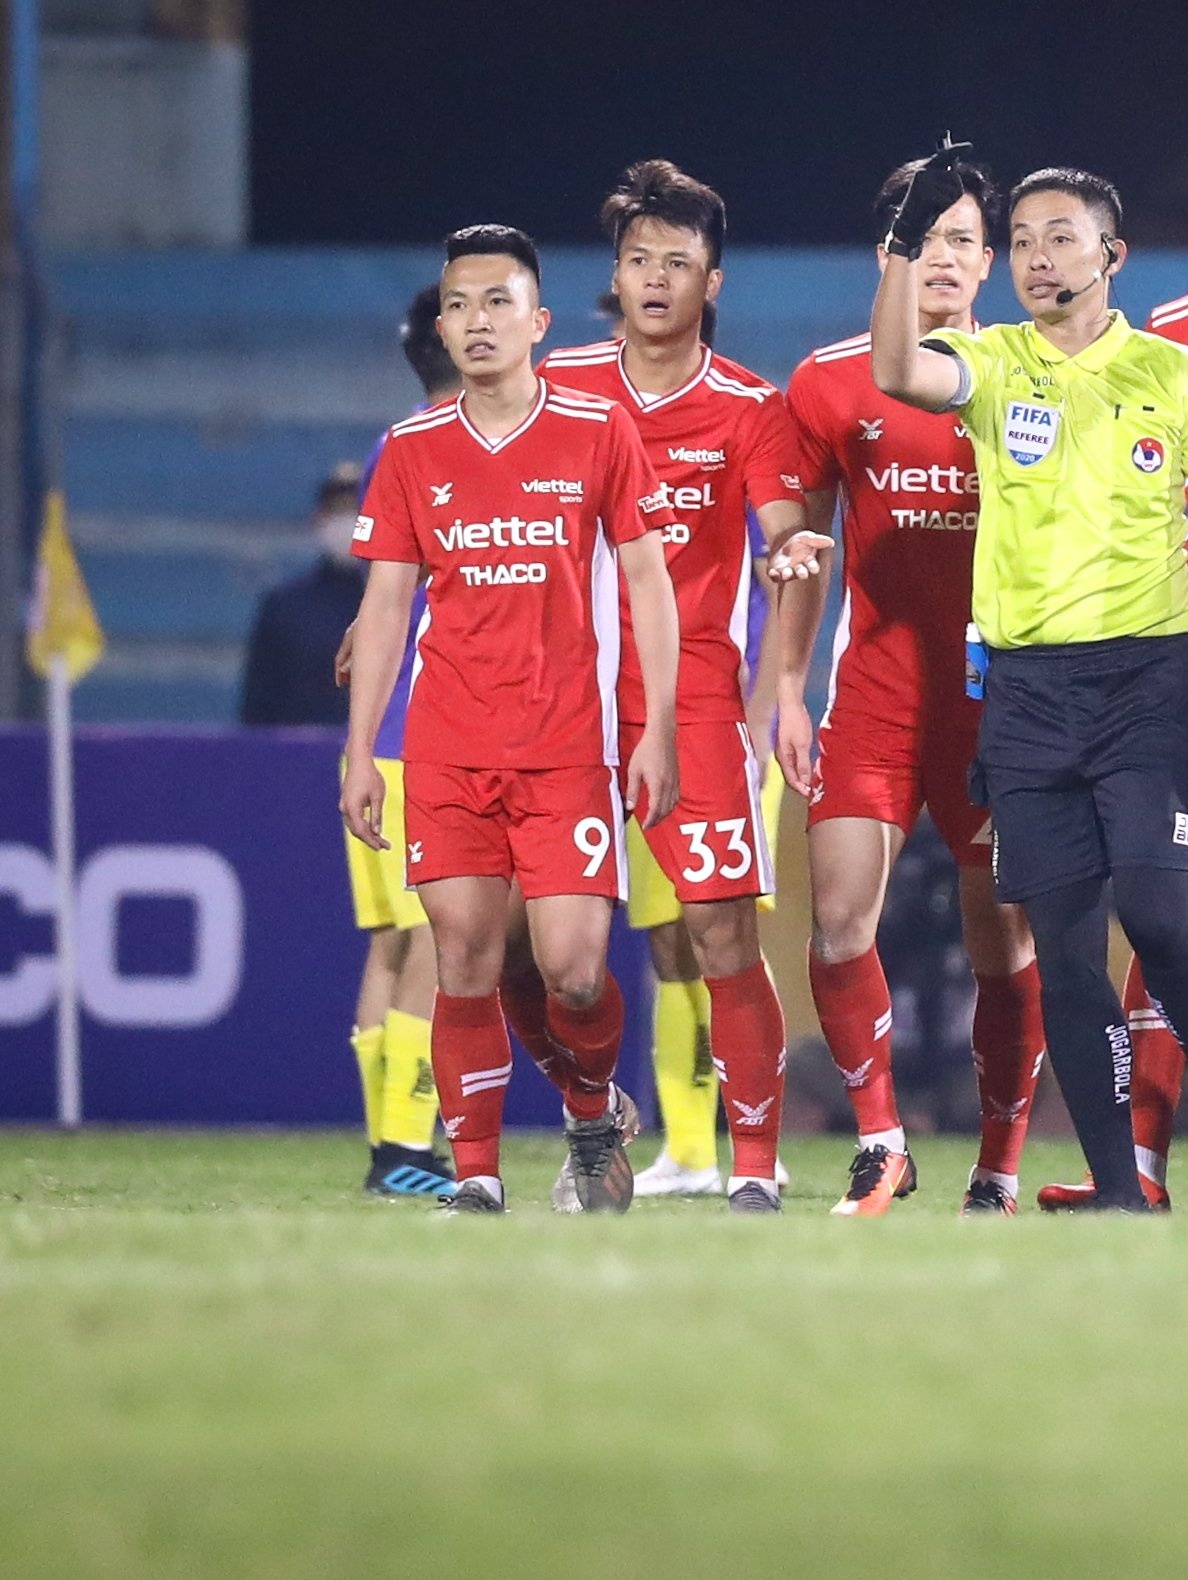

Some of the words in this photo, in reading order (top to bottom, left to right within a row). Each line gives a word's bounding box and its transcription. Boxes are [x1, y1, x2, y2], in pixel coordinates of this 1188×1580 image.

[1011, 406, 1052, 426] FIFA
[1008, 430, 1049, 445] REFEREE
[668, 447, 726, 464] viettel
[521, 479, 583, 494] viettel
[865, 463, 979, 494] viette
[559, 495, 583, 503] sports
[434, 516, 569, 552] viettel
[460, 563, 547, 586] THACO
[573, 816, 611, 878] 9
[680, 818, 752, 883] 33
[1105, 1024, 1132, 1105] JOGARBOLA
